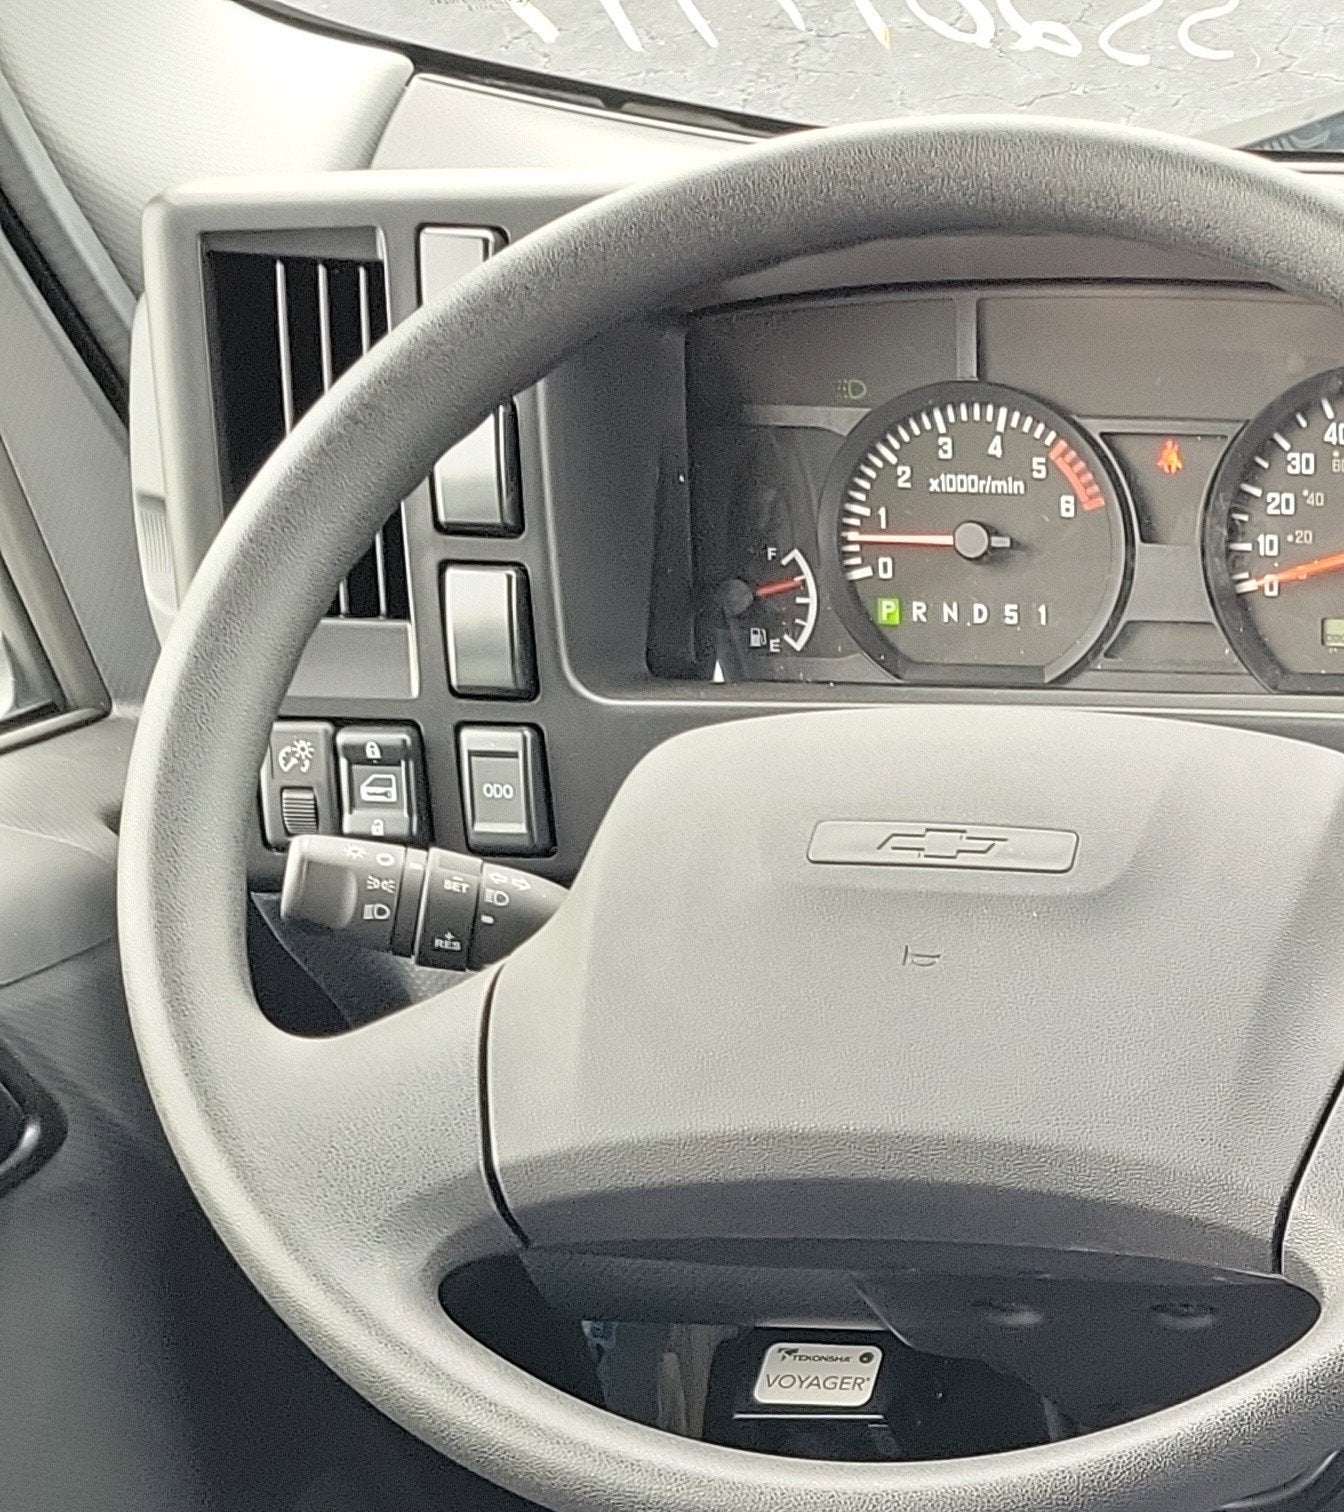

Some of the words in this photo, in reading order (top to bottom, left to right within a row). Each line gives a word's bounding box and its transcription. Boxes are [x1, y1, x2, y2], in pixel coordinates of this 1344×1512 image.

[938, 437, 953, 460] 3
[988, 434, 1002, 458] 4
[1032, 457, 1047, 479] 5
[1287, 452, 1315, 475] 30
[896, 465, 911, 488] 2
[929, 473, 1025, 494] x1000r/min
[1060, 494, 1075, 518] 6
[1266, 492, 1295, 515] 20
[1306, 491, 1324, 507] 40
[878, 506, 886, 529] 1
[1257, 533, 1279, 556] 10
[1295, 530, 1313, 545] 20
[767, 548, 777, 561] F
[878, 557, 893, 579] 0
[1264, 574, 1279, 597] 0
[881, 601, 896, 621] P
[912, 602, 927, 622] R
[942, 602, 958, 622] N
[973, 603, 988, 624] D
[1003, 604, 1019, 625] 5
[1038, 604, 1047, 625] 1
[769, 638, 781, 653] E
[483, 783, 514, 799] ODO
[443, 879, 470, 893] SET
